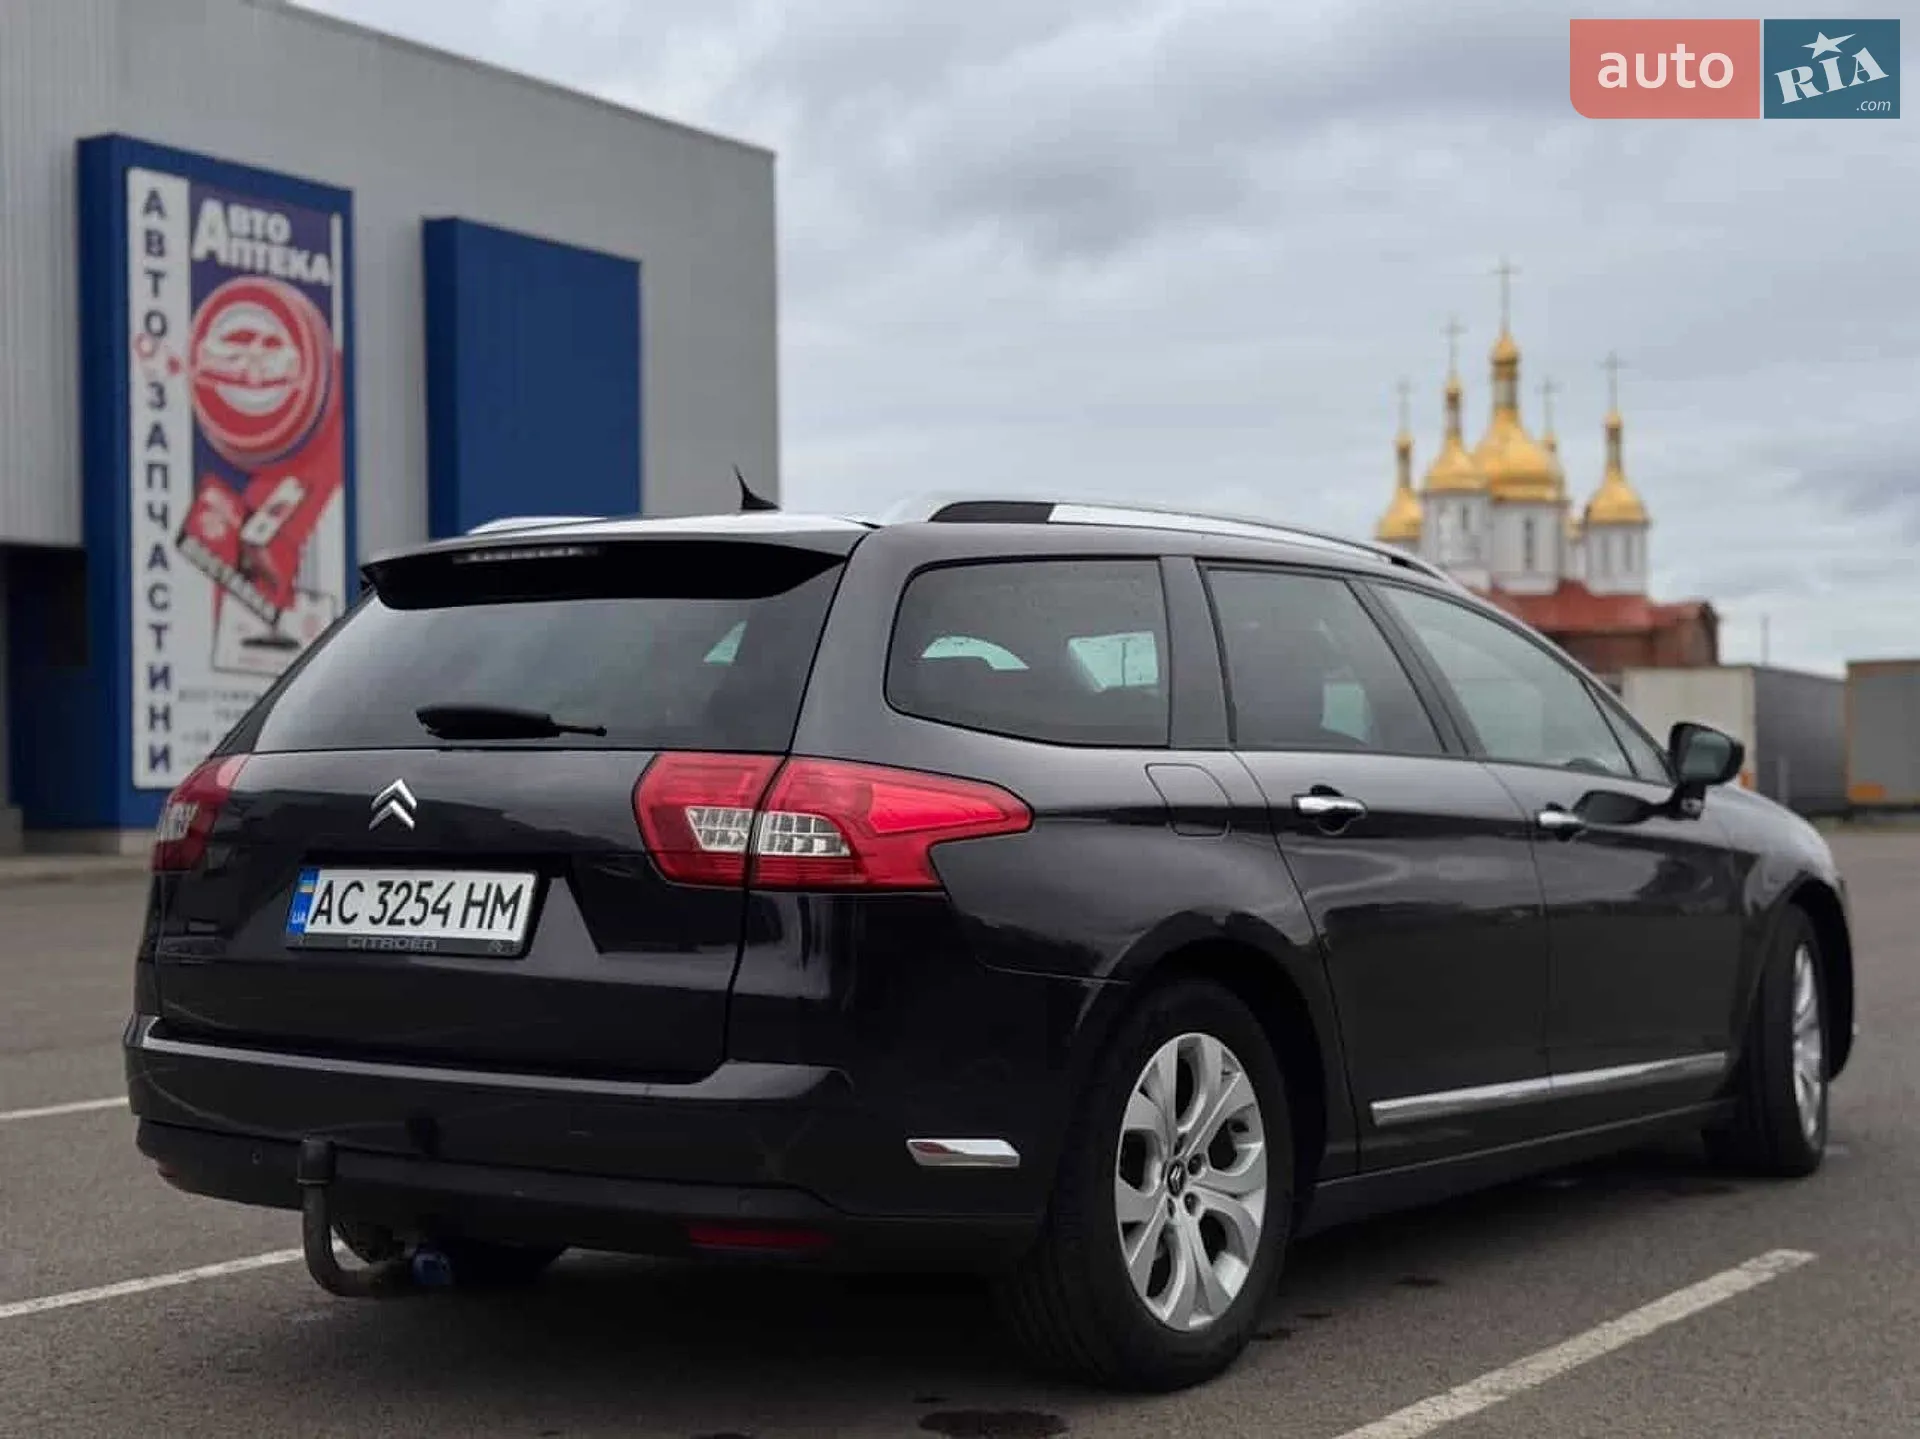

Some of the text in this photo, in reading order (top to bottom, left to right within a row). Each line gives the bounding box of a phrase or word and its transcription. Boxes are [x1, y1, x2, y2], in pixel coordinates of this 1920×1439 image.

[310, 879, 523, 930] AC 3254 HM
